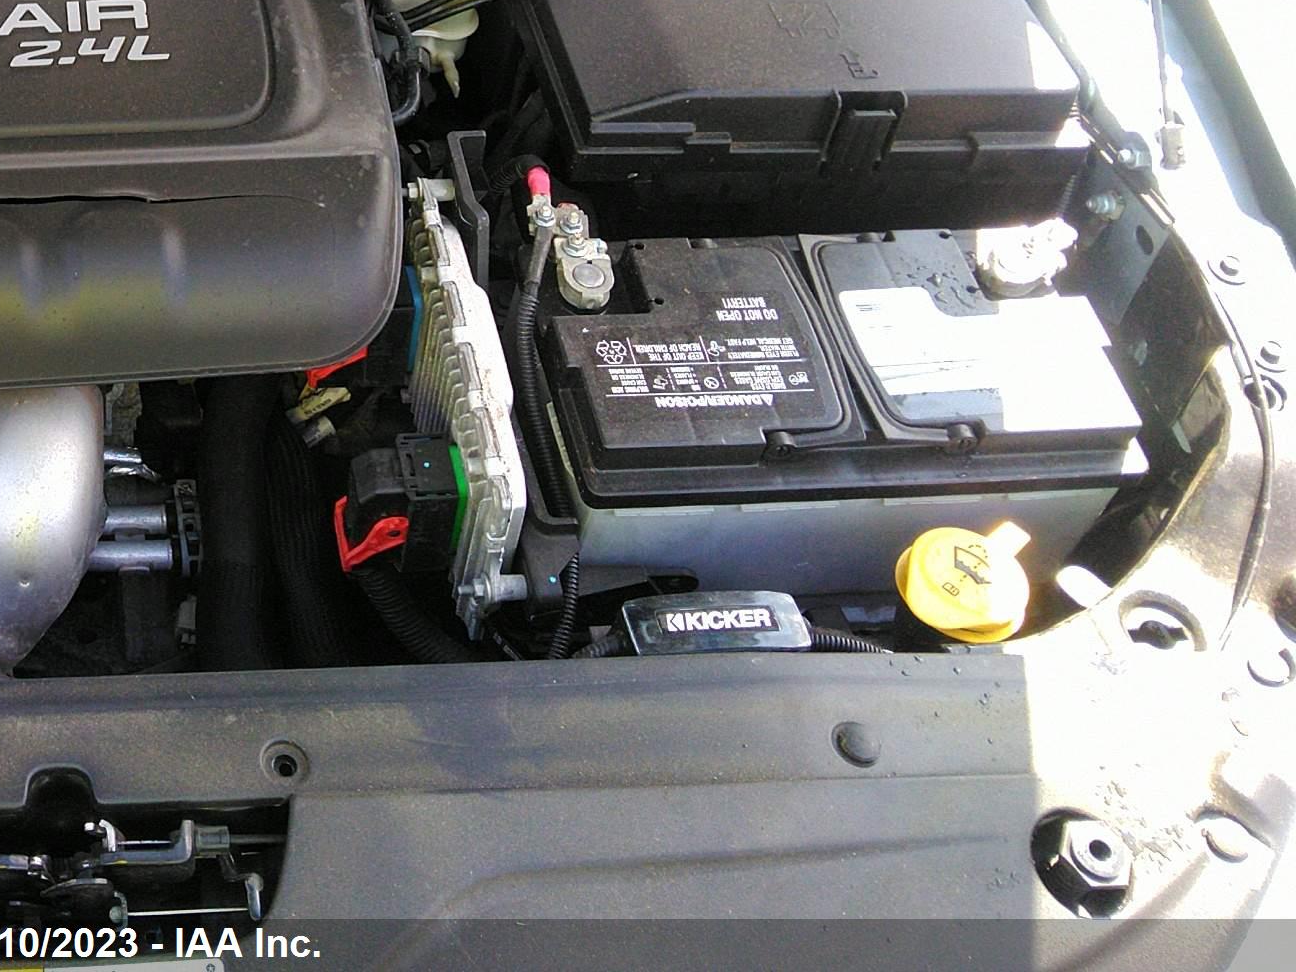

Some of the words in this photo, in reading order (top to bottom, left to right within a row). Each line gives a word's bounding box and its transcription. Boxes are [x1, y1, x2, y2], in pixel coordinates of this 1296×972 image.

[9, 35, 171, 69] 2.4L
[715, 310, 742, 322] OPEN
[742, 309, 763, 321] NOT
[762, 308, 778, 320] DO
[684, 607, 772, 632] KICKER
